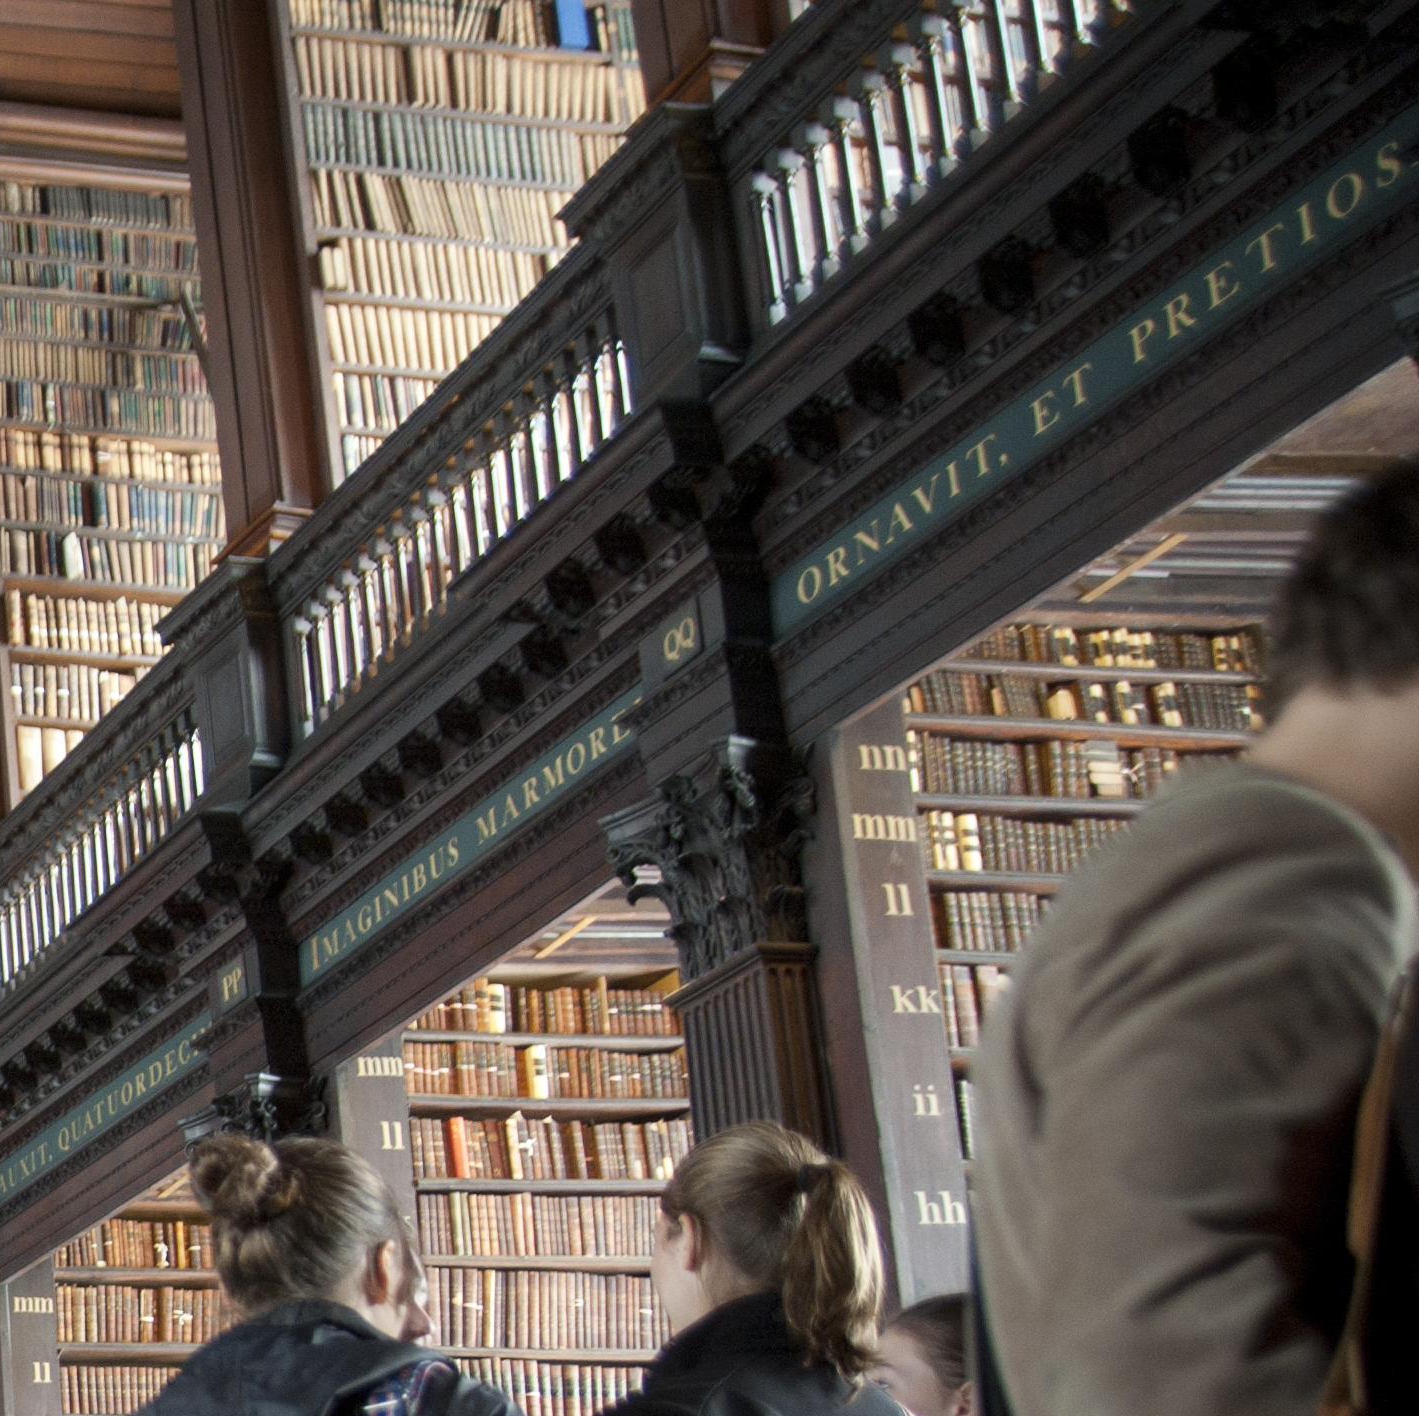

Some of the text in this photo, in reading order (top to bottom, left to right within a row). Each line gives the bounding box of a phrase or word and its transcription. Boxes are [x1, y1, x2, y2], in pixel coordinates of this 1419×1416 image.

[796, 141, 1419, 604] ORNAVIT, ET PRETIOS
[859, 744, 907, 771] nn
[852, 814, 916, 842] mm
[310, 836, 461, 972] IMAGINIBUS
[882, 883, 914, 916] ll
[222, 967, 242, 1002] PP
[891, 985, 941, 1014] kk
[357, 1056, 403, 1077] mm
[913, 1085, 942, 1116] ii
[381, 1121, 405, 1150] ll
[914, 1191, 966, 1224] hh
[14, 1297, 53, 1313] mm
[33, 1362, 51, 1383] ll
